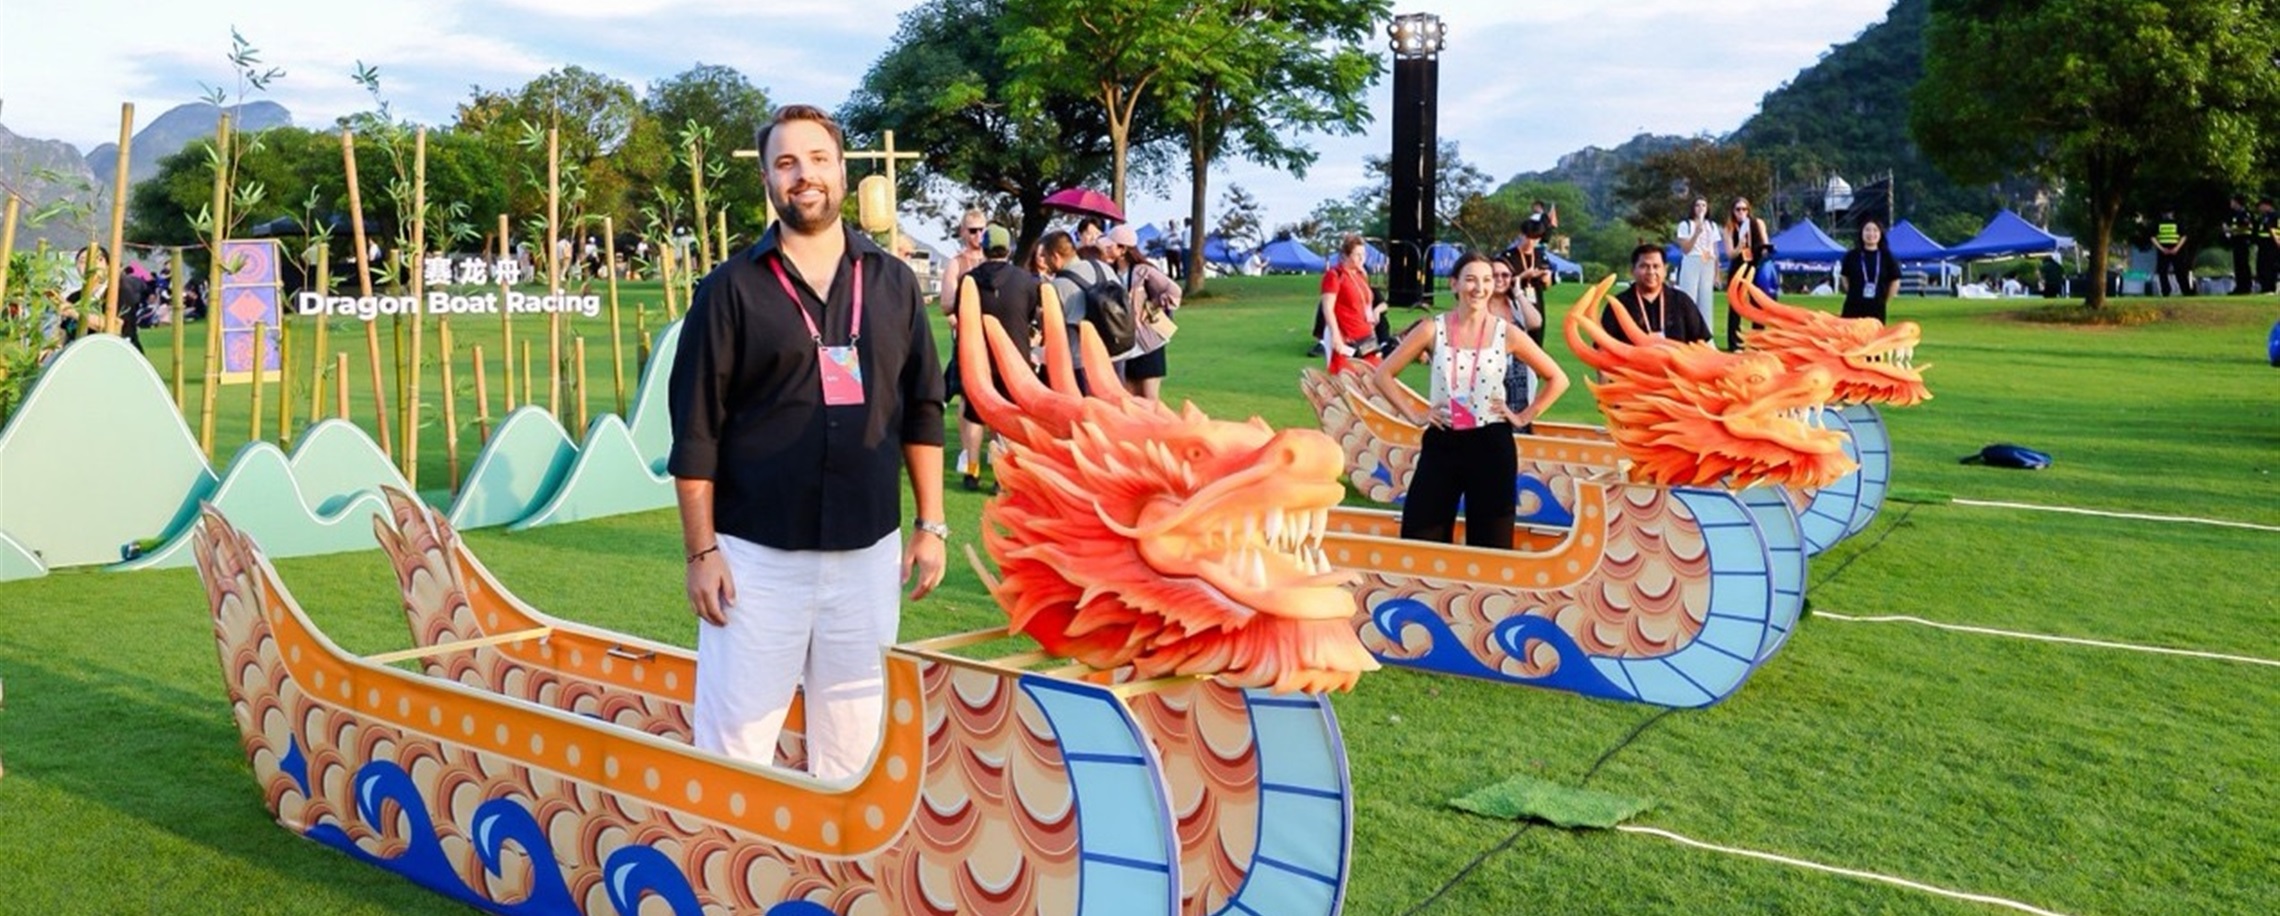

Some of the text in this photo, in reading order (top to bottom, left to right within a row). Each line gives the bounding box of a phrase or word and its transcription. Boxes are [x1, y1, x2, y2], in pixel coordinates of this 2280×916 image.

[424, 257, 521, 285] 赛龙舟
[299, 288, 600, 320] Dragon Boat Racing
